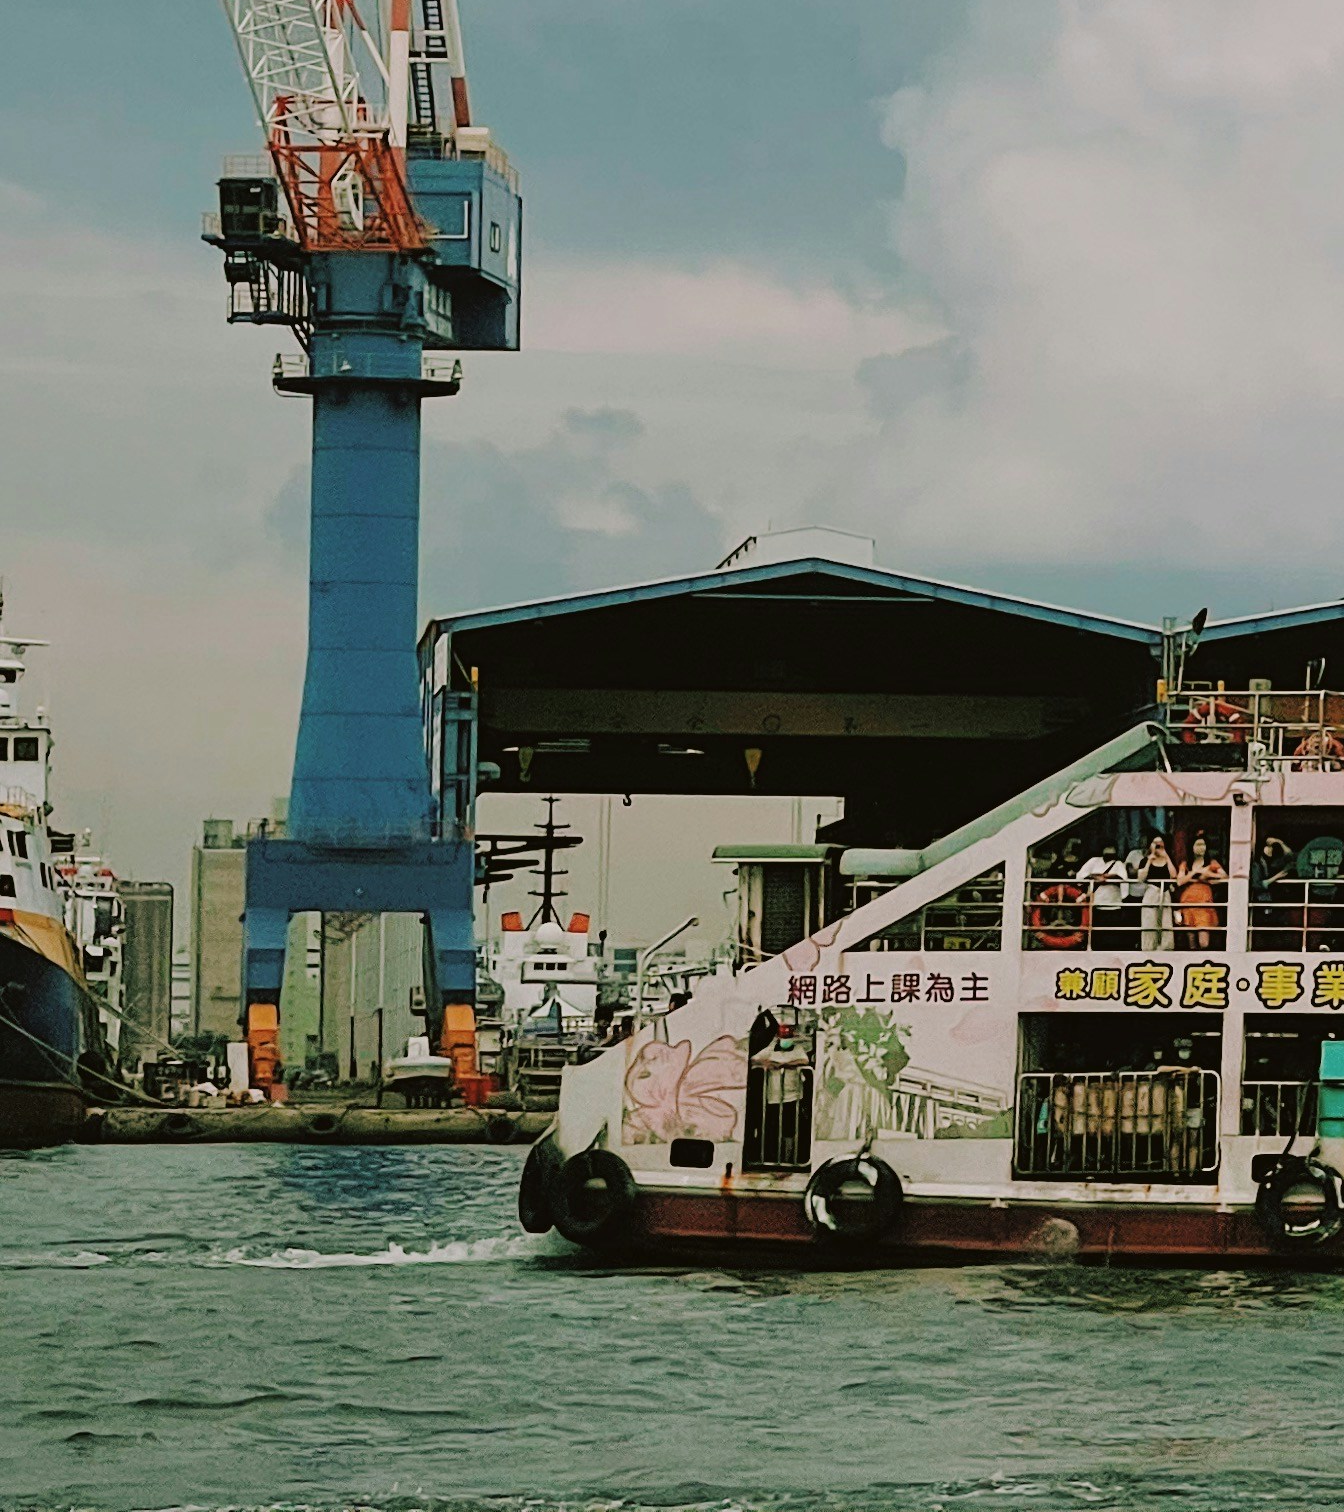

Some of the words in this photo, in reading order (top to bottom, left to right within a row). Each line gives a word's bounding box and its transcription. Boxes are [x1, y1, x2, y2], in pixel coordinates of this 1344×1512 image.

[787, 972, 990, 1005] 網路上課為主
